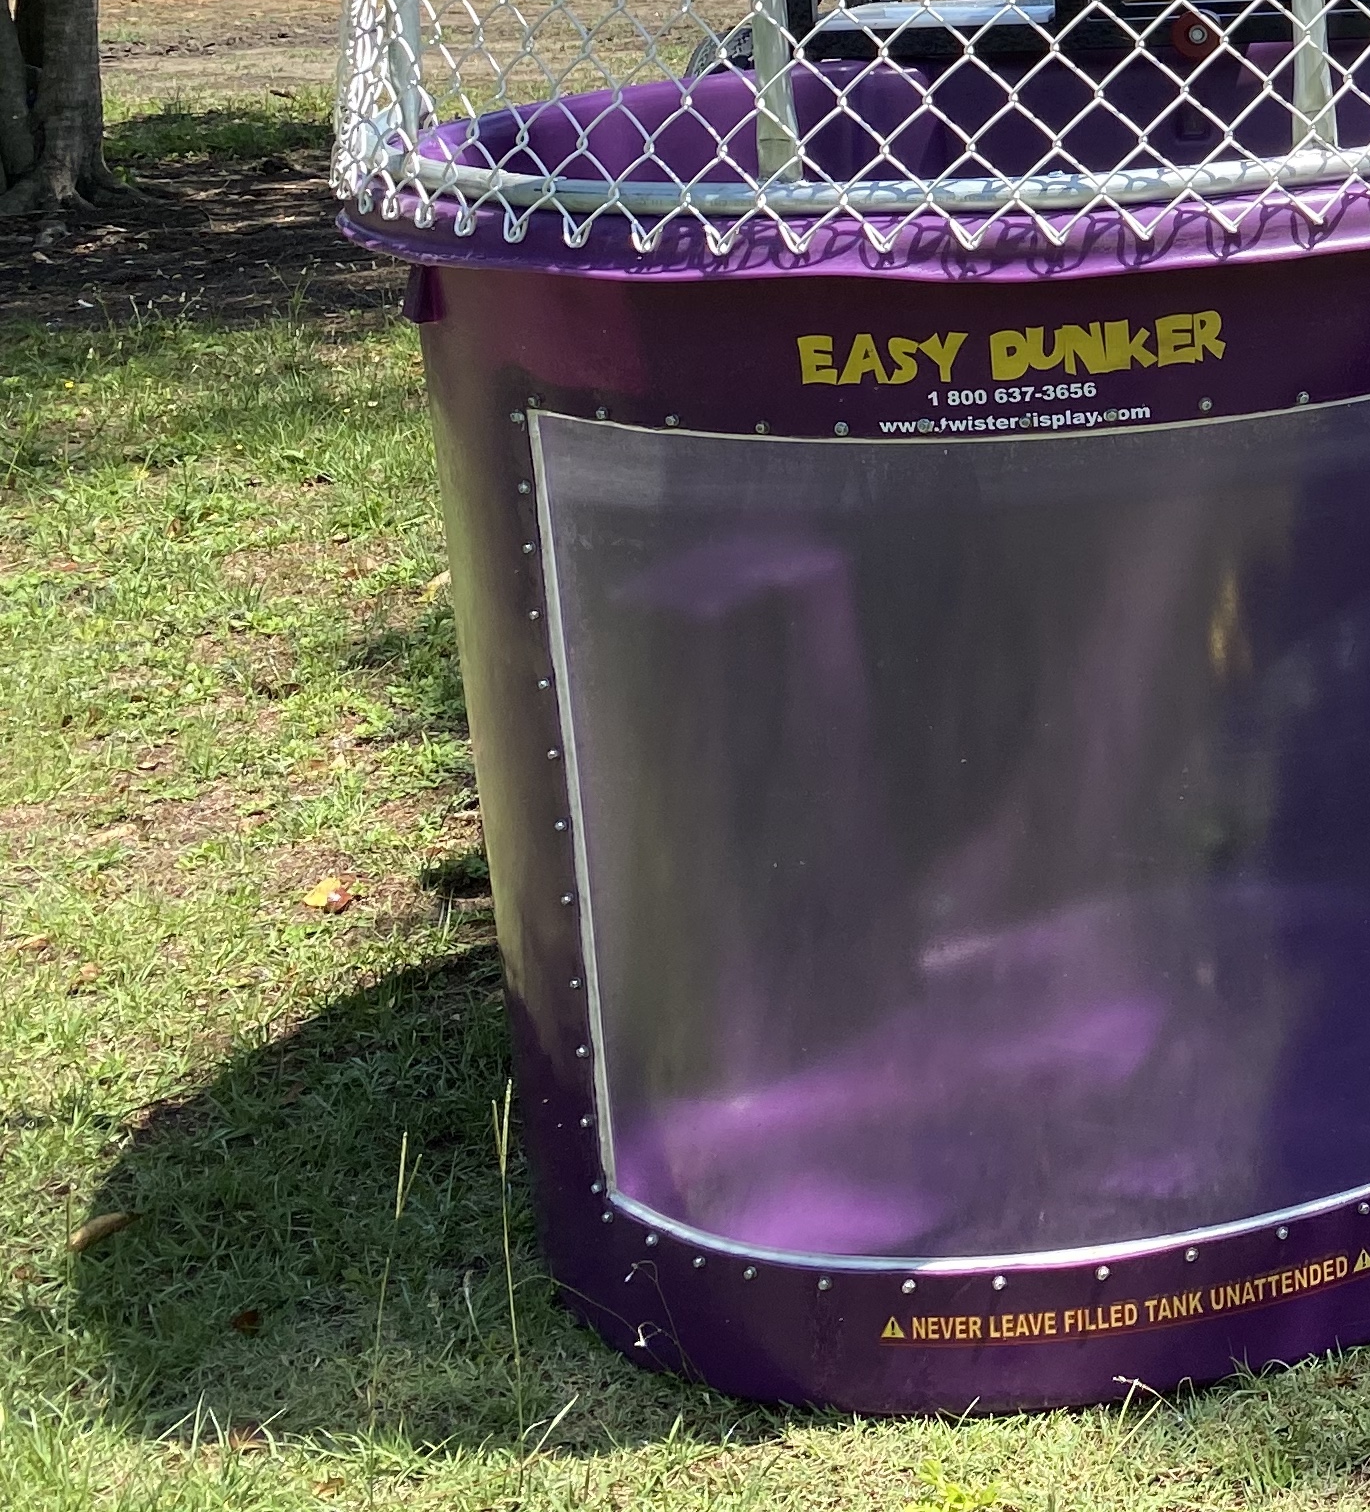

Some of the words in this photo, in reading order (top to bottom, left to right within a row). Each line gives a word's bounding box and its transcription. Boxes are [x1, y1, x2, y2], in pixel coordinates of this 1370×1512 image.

[797, 332, 968, 385] EASY
[989, 310, 1226, 381] DUNKER
[927, 391, 939, 406] 1
[947, 389, 987, 406] 800
[994, 381, 1097, 404] 637-3656
[911, 1316, 982, 1339] NEVER
[989, 1311, 1057, 1338] LEAVE
[1063, 1302, 1138, 1333] FILLED
[1144, 1291, 1204, 1322] TANK
[1210, 1255, 1348, 1310] UNATTENDED
